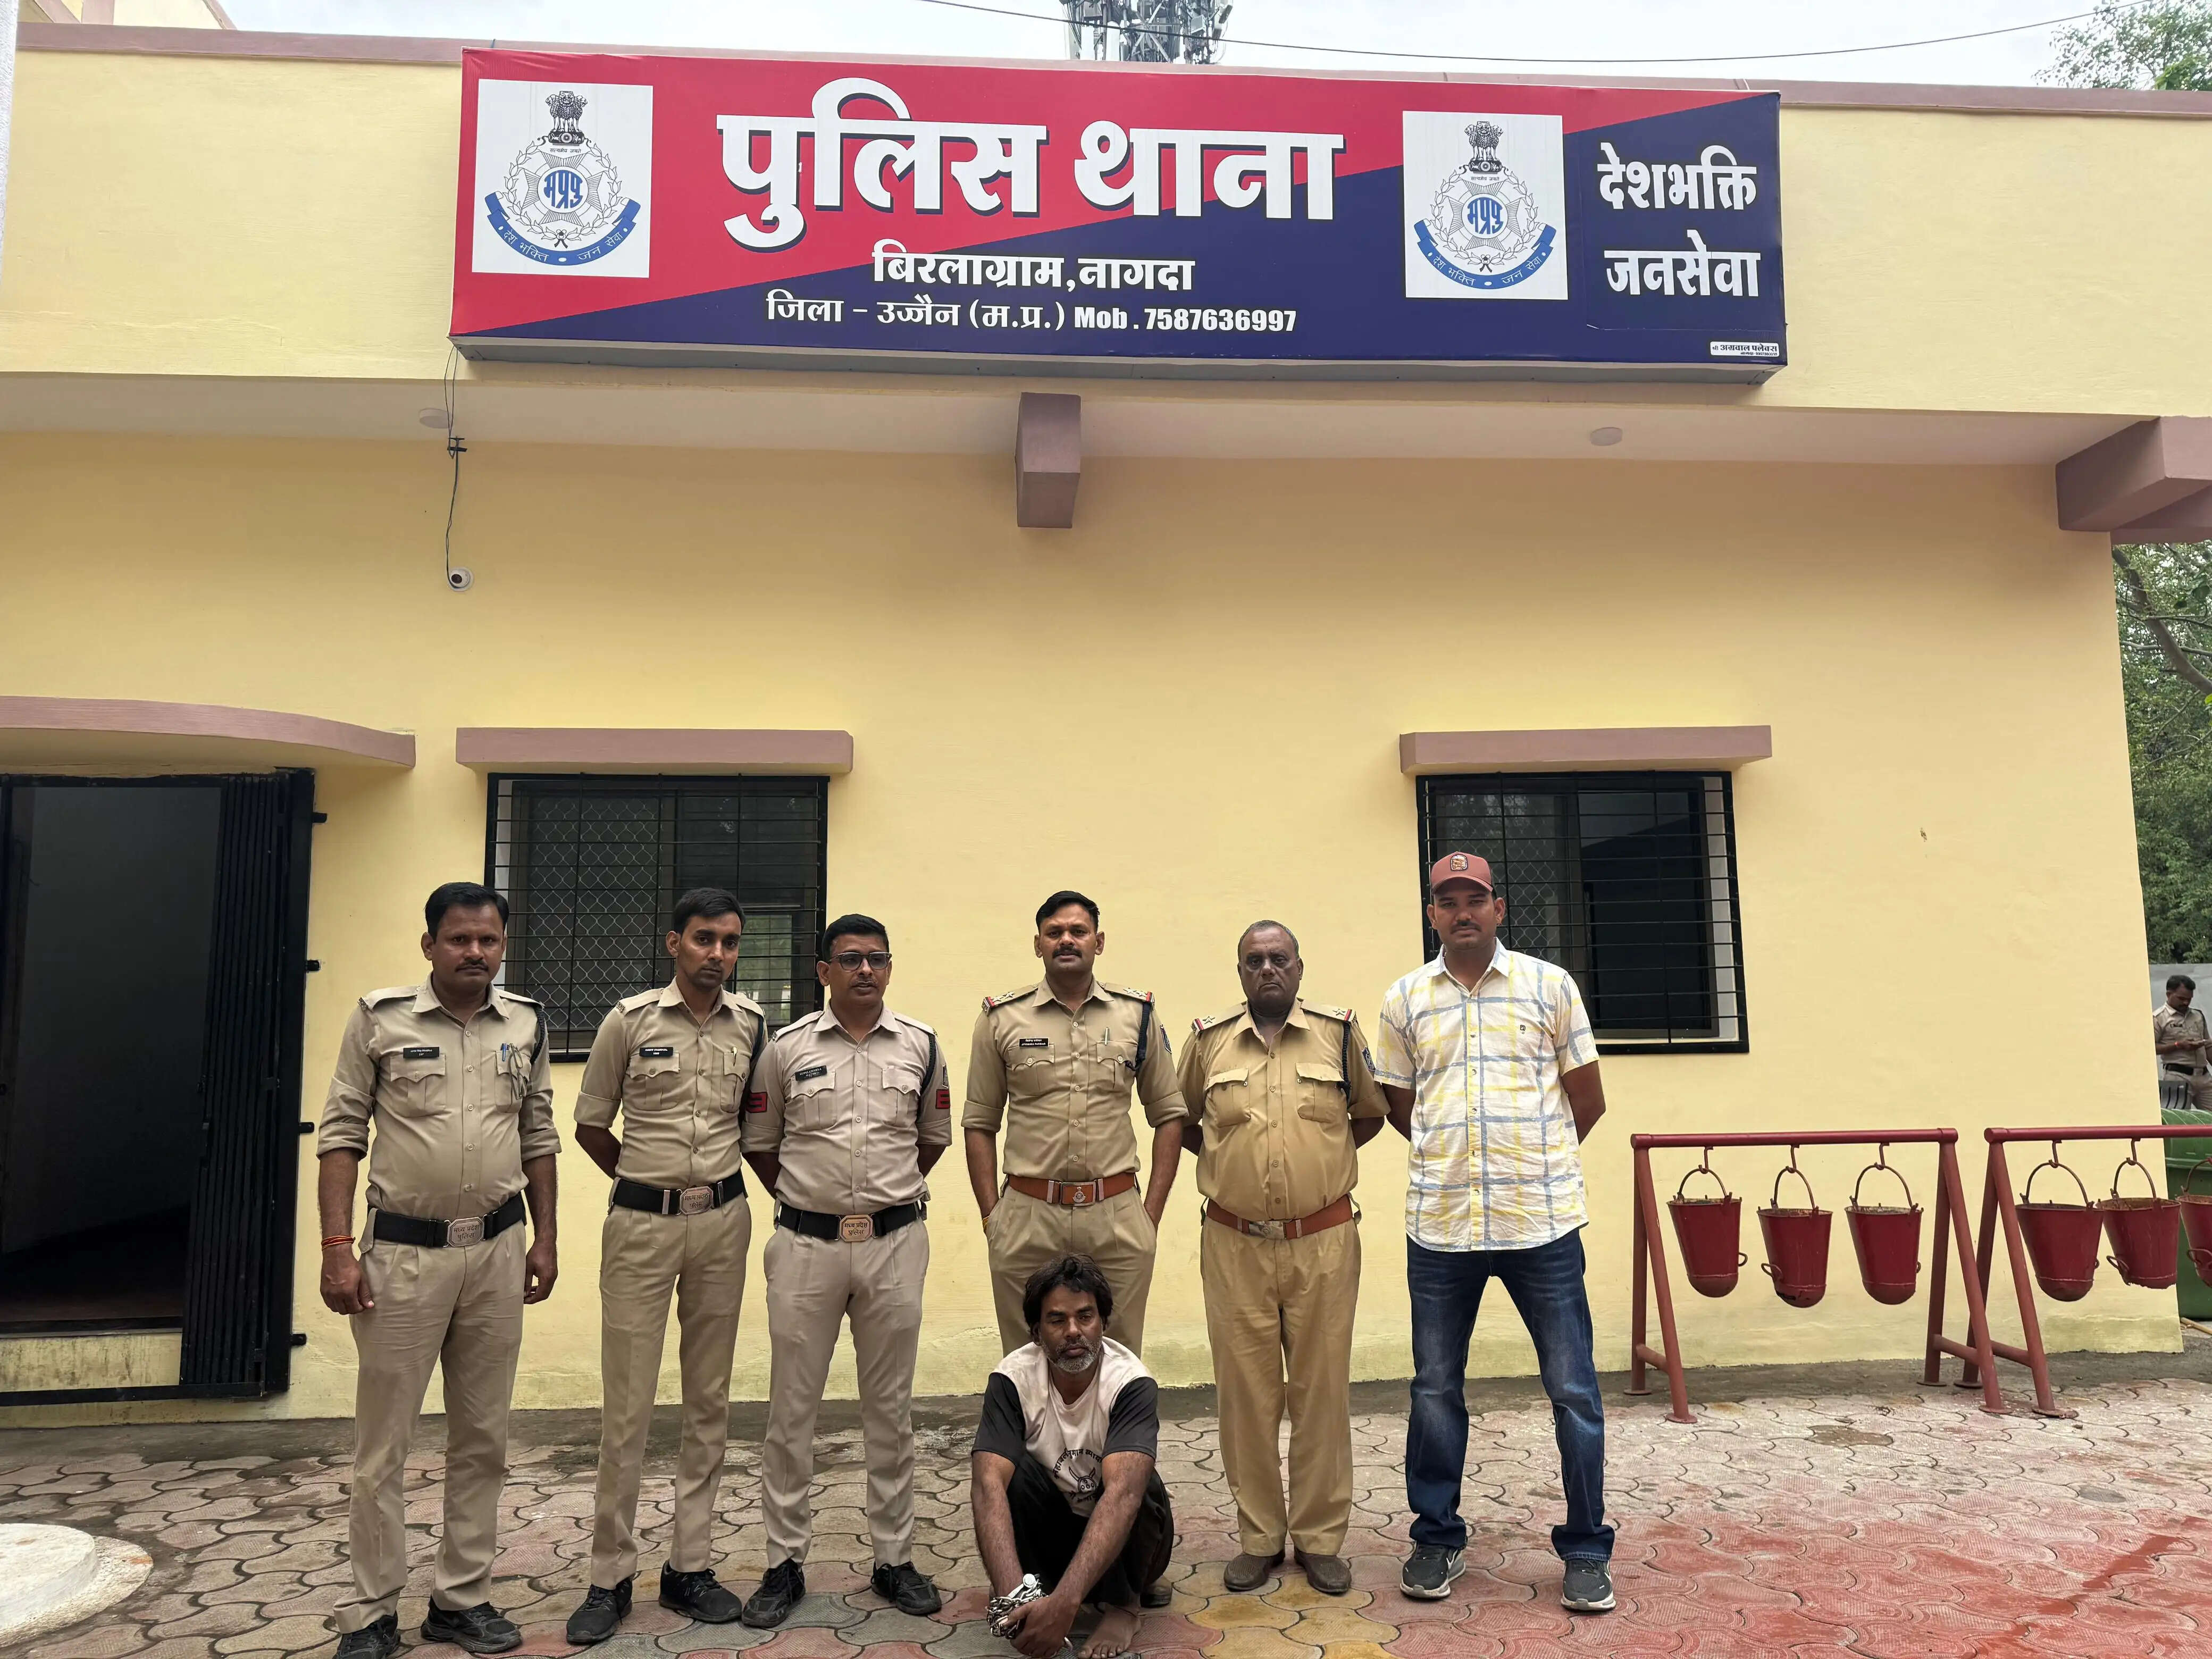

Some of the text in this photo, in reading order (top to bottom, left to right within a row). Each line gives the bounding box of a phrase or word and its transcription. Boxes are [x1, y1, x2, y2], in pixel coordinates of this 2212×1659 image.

[716, 77, 1343, 248] पुलिस थाना
[1597, 143, 1757, 210] देशभक्ति
[504, 229, 623, 263] देश भक्ति जन सेवा
[1433, 256, 1542, 286] देश भक्ति जन सेवा
[1604, 229, 1761, 297] जनसेवा
[766, 289, 844, 322] जिला
[877, 294, 961, 326] उज्जैन
[1144, 308, 1296, 331] 7587636997
